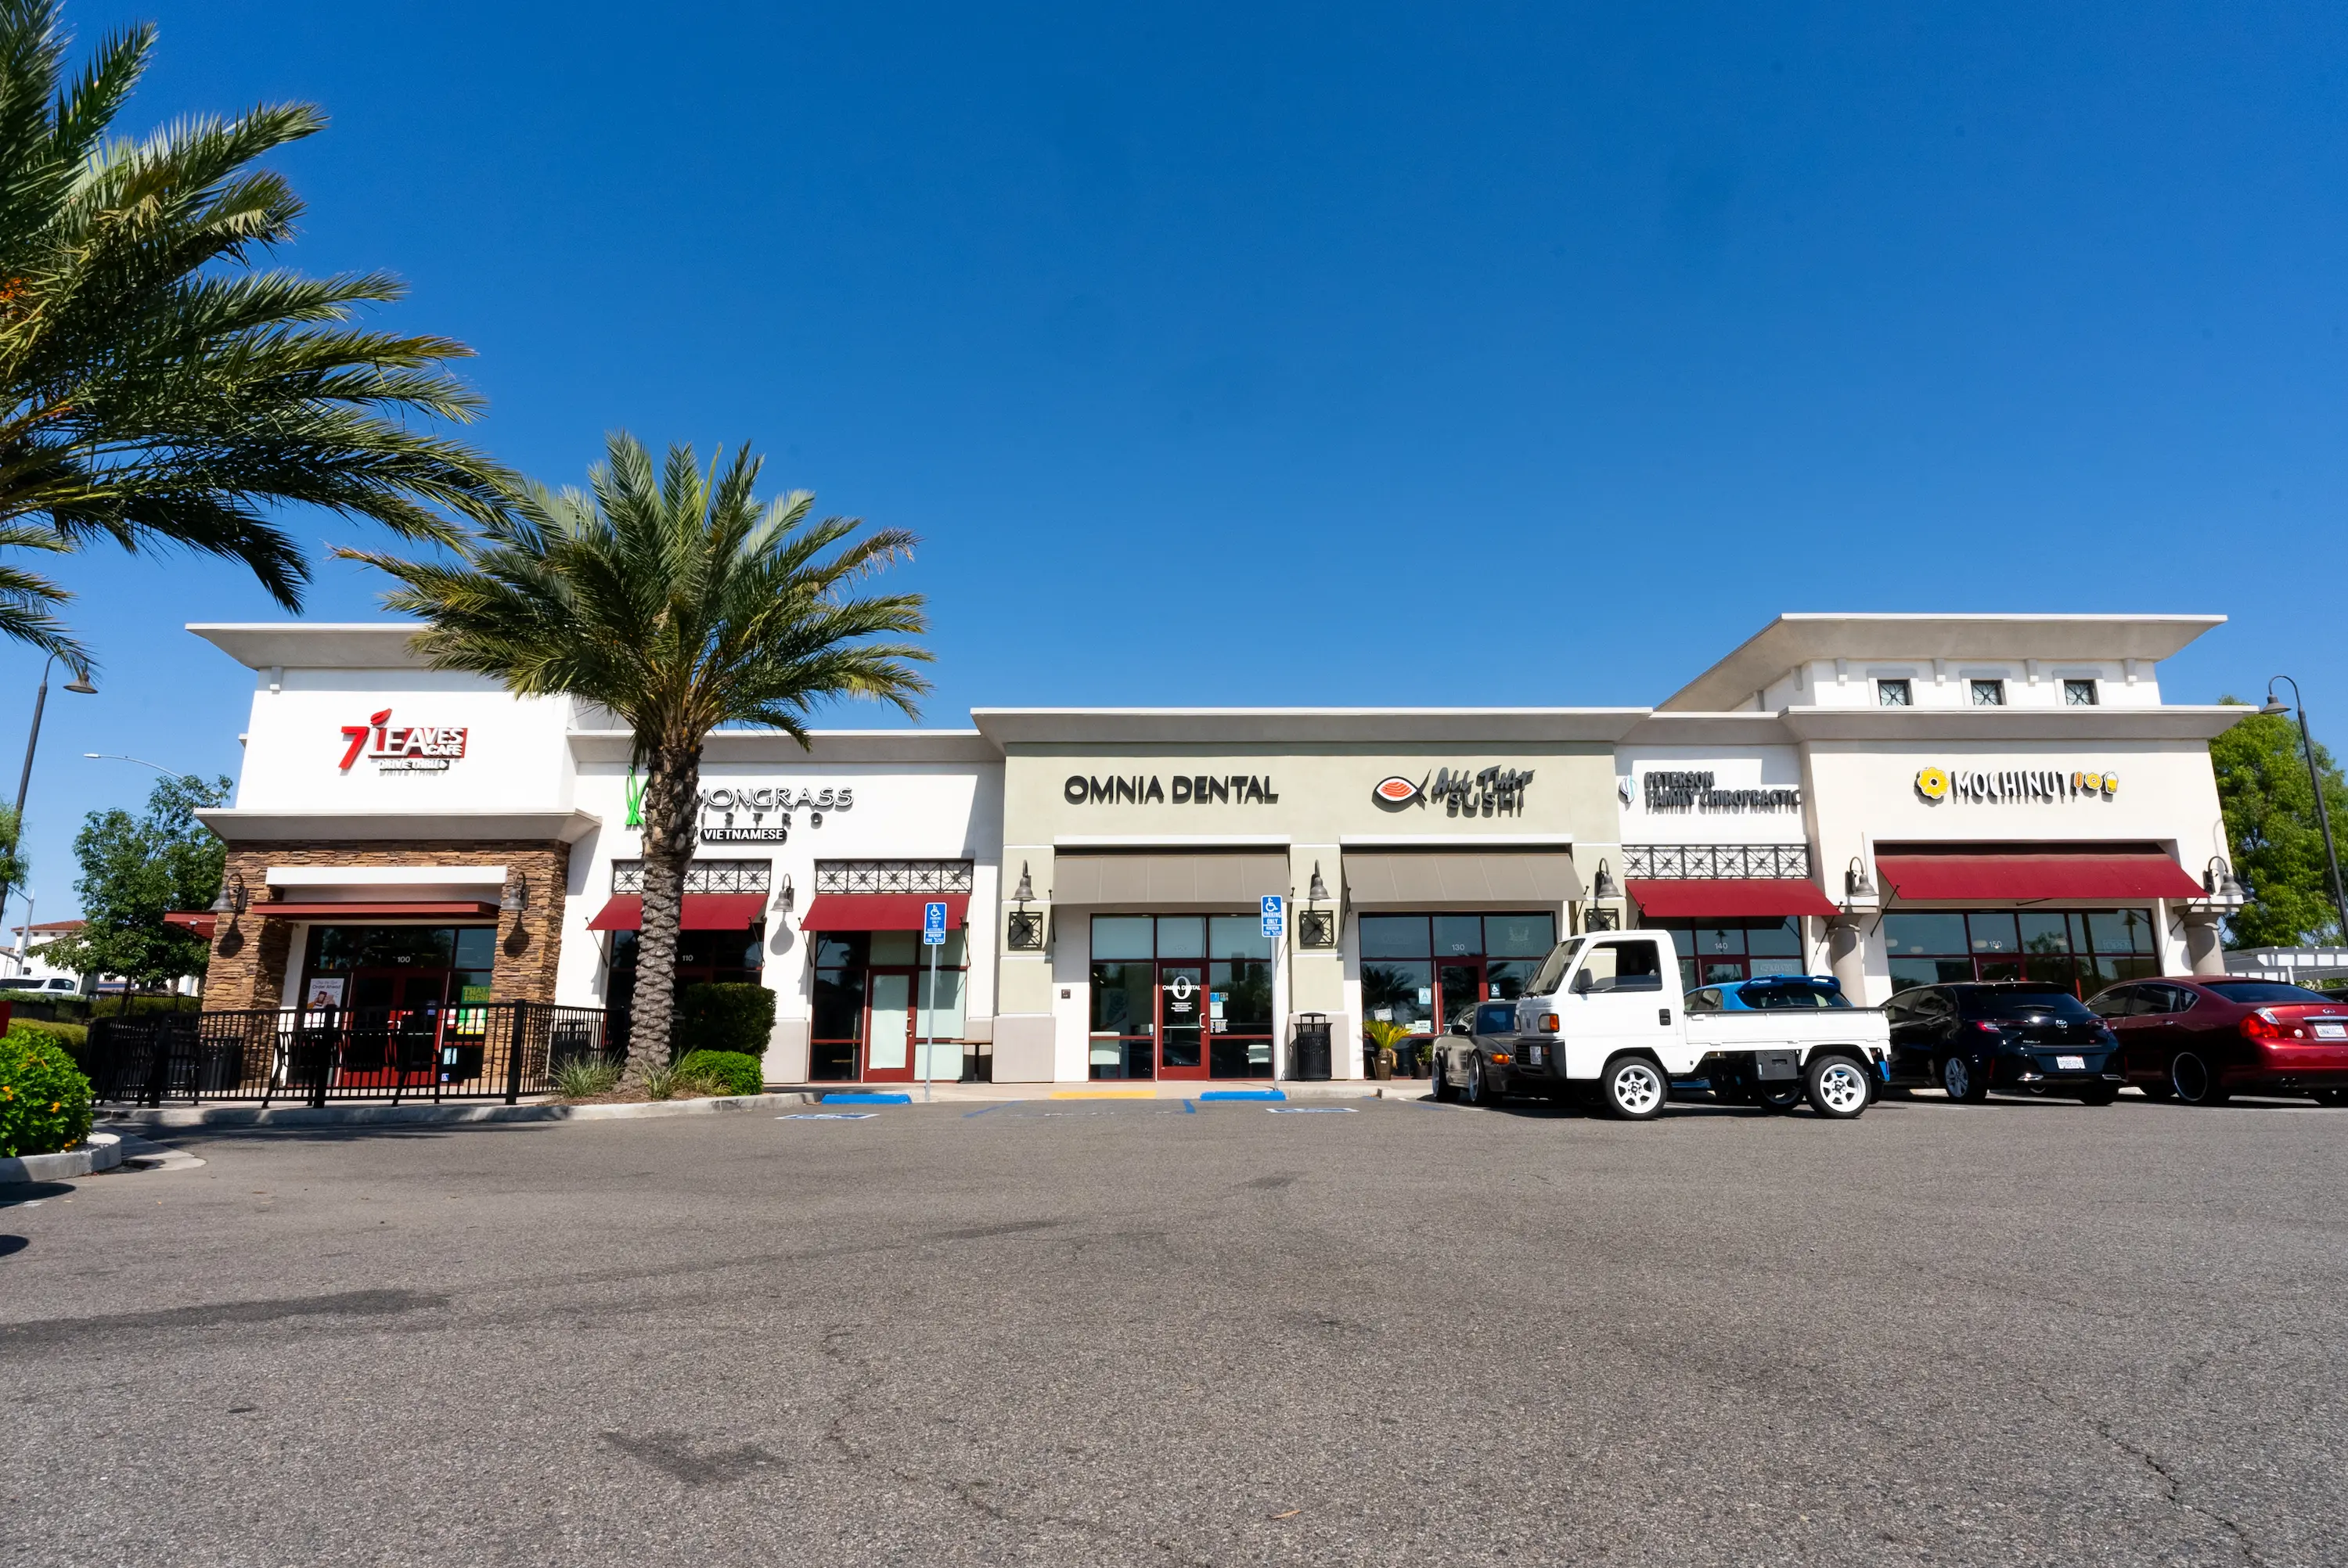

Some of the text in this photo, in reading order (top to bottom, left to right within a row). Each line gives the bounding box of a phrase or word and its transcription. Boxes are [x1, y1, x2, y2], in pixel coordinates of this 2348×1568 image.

[338, 726, 464, 770] 7 LEAVES
[427, 744, 463, 756] CAFE
[1644, 771, 1715, 786] PETERSON
[1955, 771, 2069, 797] MOCHINUT
[1064, 775, 1279, 804] OMNIA DENTAL
[1645, 789, 1801, 805] FAMILY CHIROPRACTIC
[1448, 793, 1524, 808] SUSHI
[700, 812, 823, 824] ISTRO
[704, 829, 783, 840] VIETNAMESE
